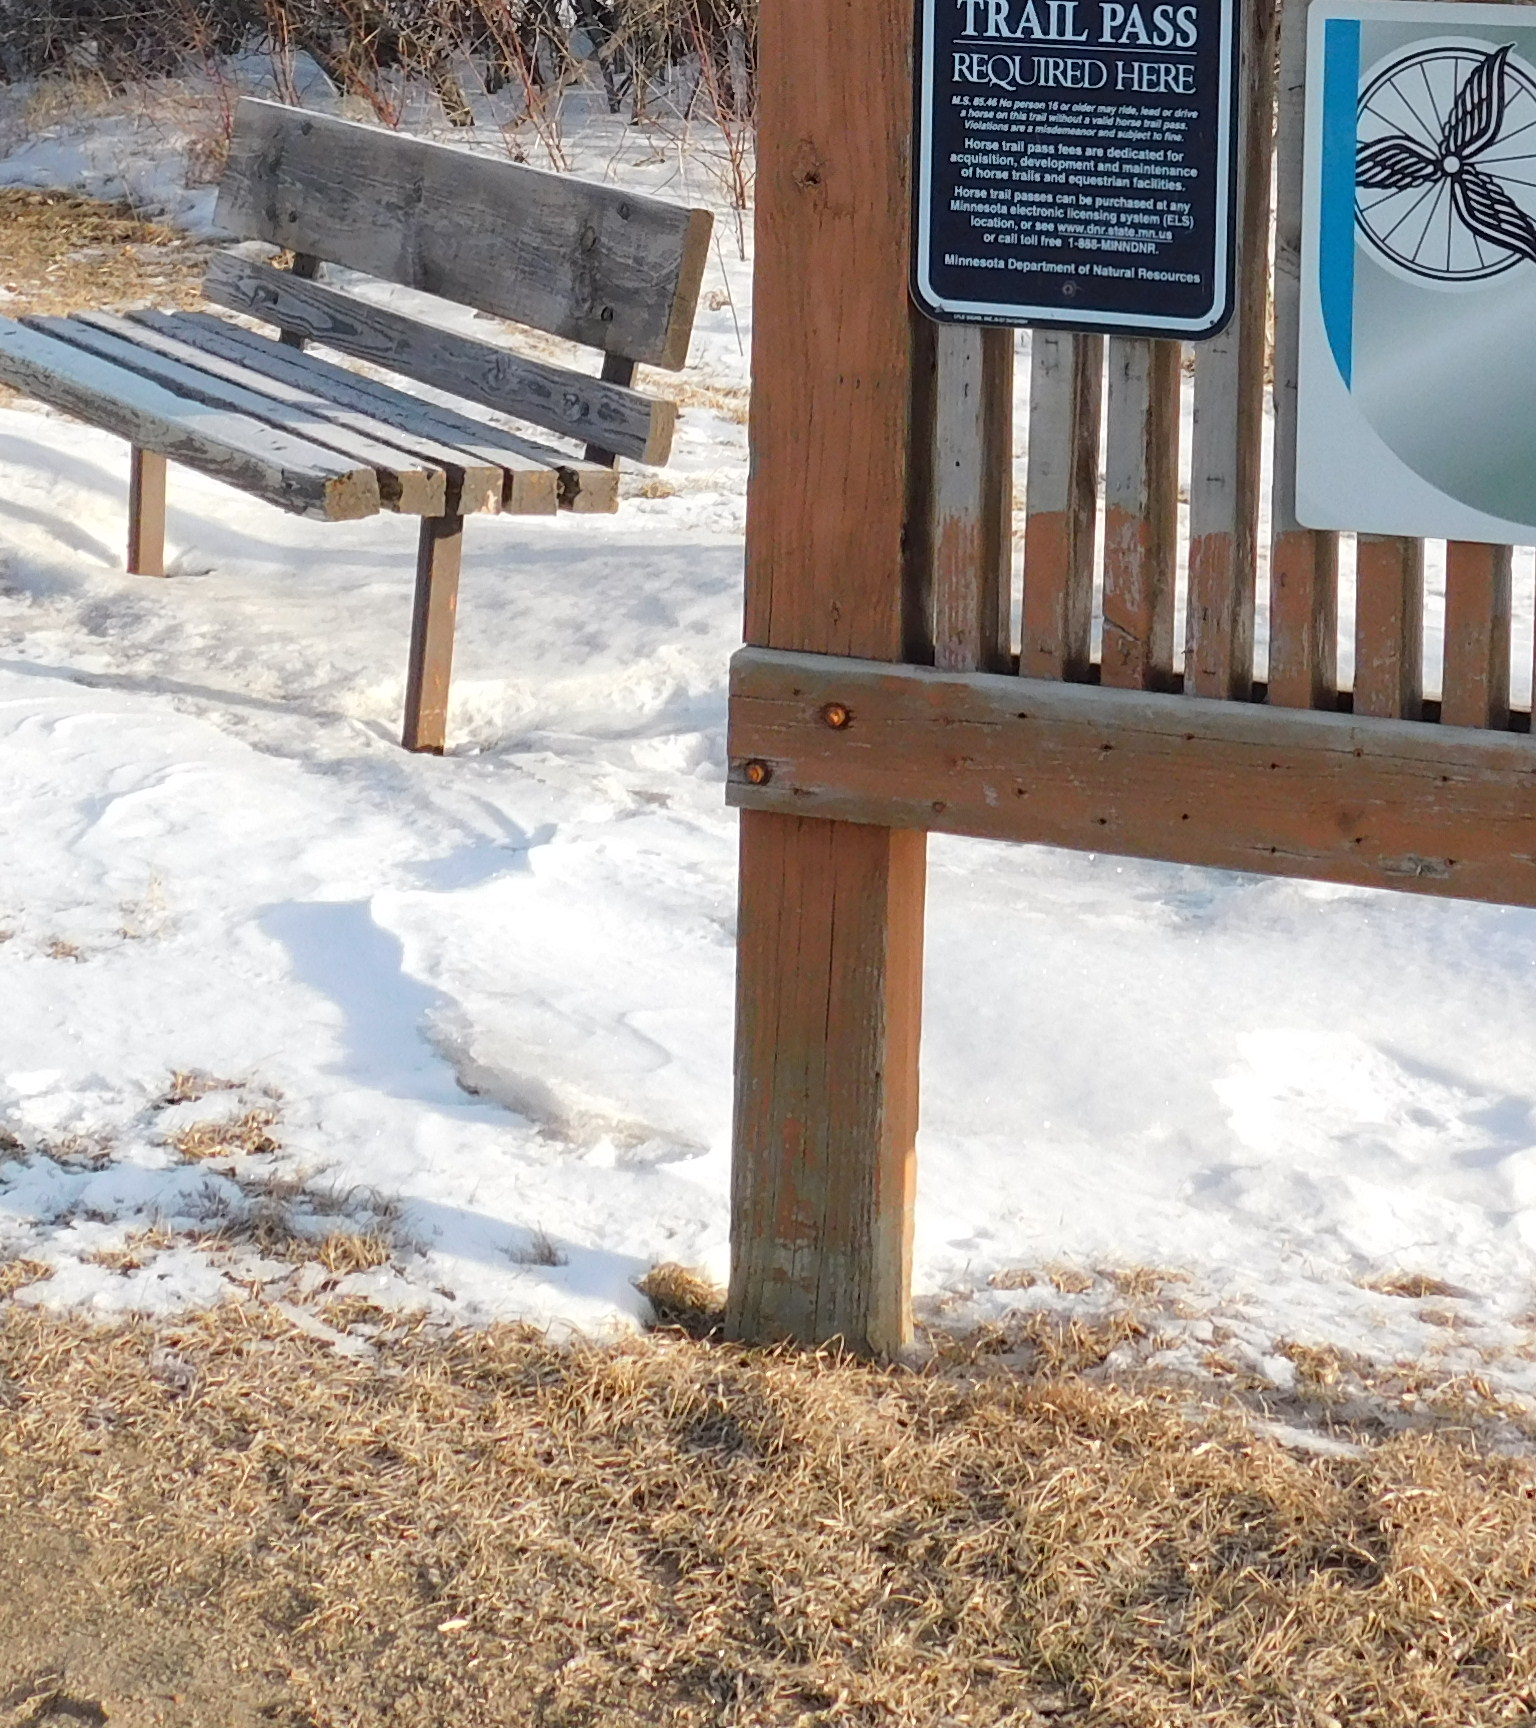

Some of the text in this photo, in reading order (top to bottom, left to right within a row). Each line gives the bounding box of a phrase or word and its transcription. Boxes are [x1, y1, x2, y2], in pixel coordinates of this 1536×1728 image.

[1099, 3, 1197, 47] PASS
[953, 53, 1195, 93] REQUIRED HERE
[965, 138, 1184, 161] Horse trail pass fees are dedicated for
[950, 153, 1197, 177] acquisition, development and maintenance
[961, 167, 1185, 191] of horse trails and equestrian facilities.
[954, 186, 1190, 214] Horse trail passes can be purchased at any
[950, 200, 1193, 229] Minnesota electronic licensing system (ELS)
[945, 254, 1200, 283] Minnesota Department of Natural Resources
